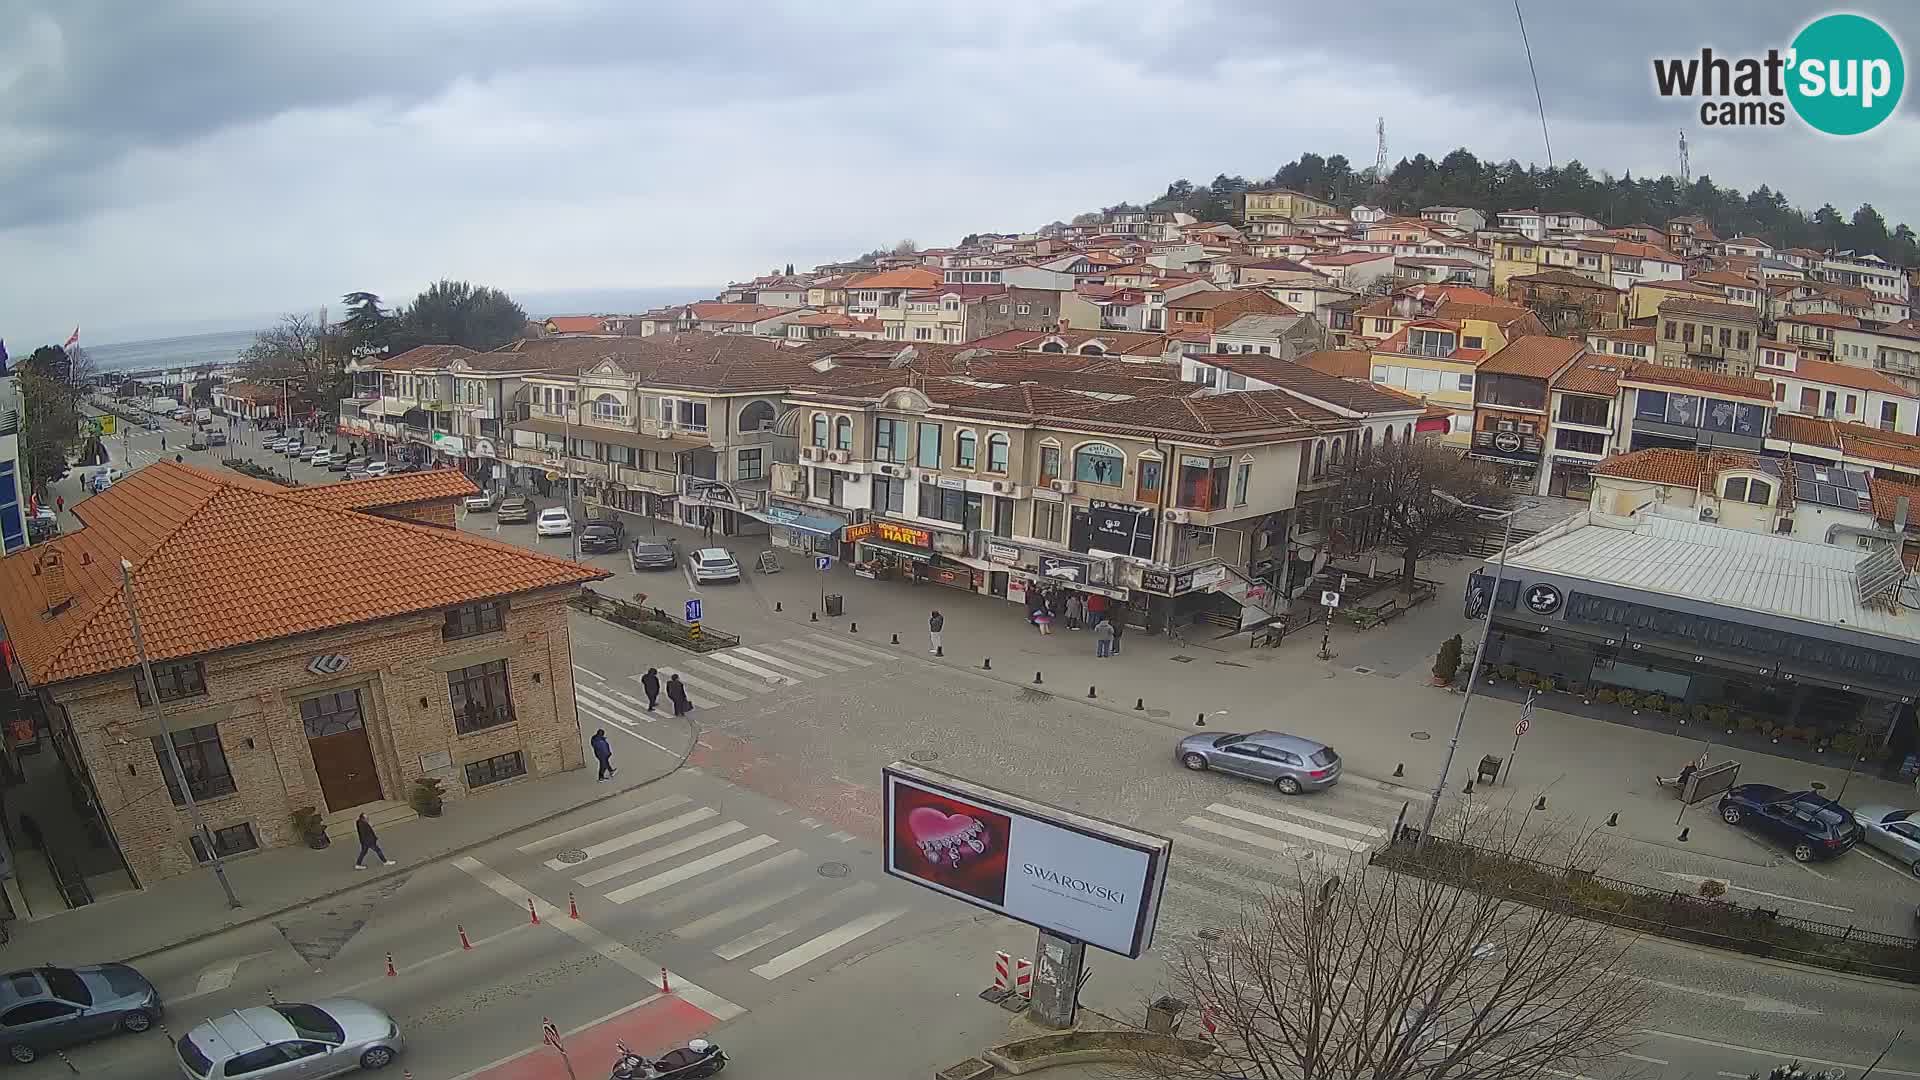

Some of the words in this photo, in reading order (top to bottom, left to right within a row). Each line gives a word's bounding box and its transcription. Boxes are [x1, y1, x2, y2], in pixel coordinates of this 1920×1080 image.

[883, 529, 916, 545] HARI
[819, 558, 827, 568] P
[1023, 863, 1126, 905] SWAROVSKI
